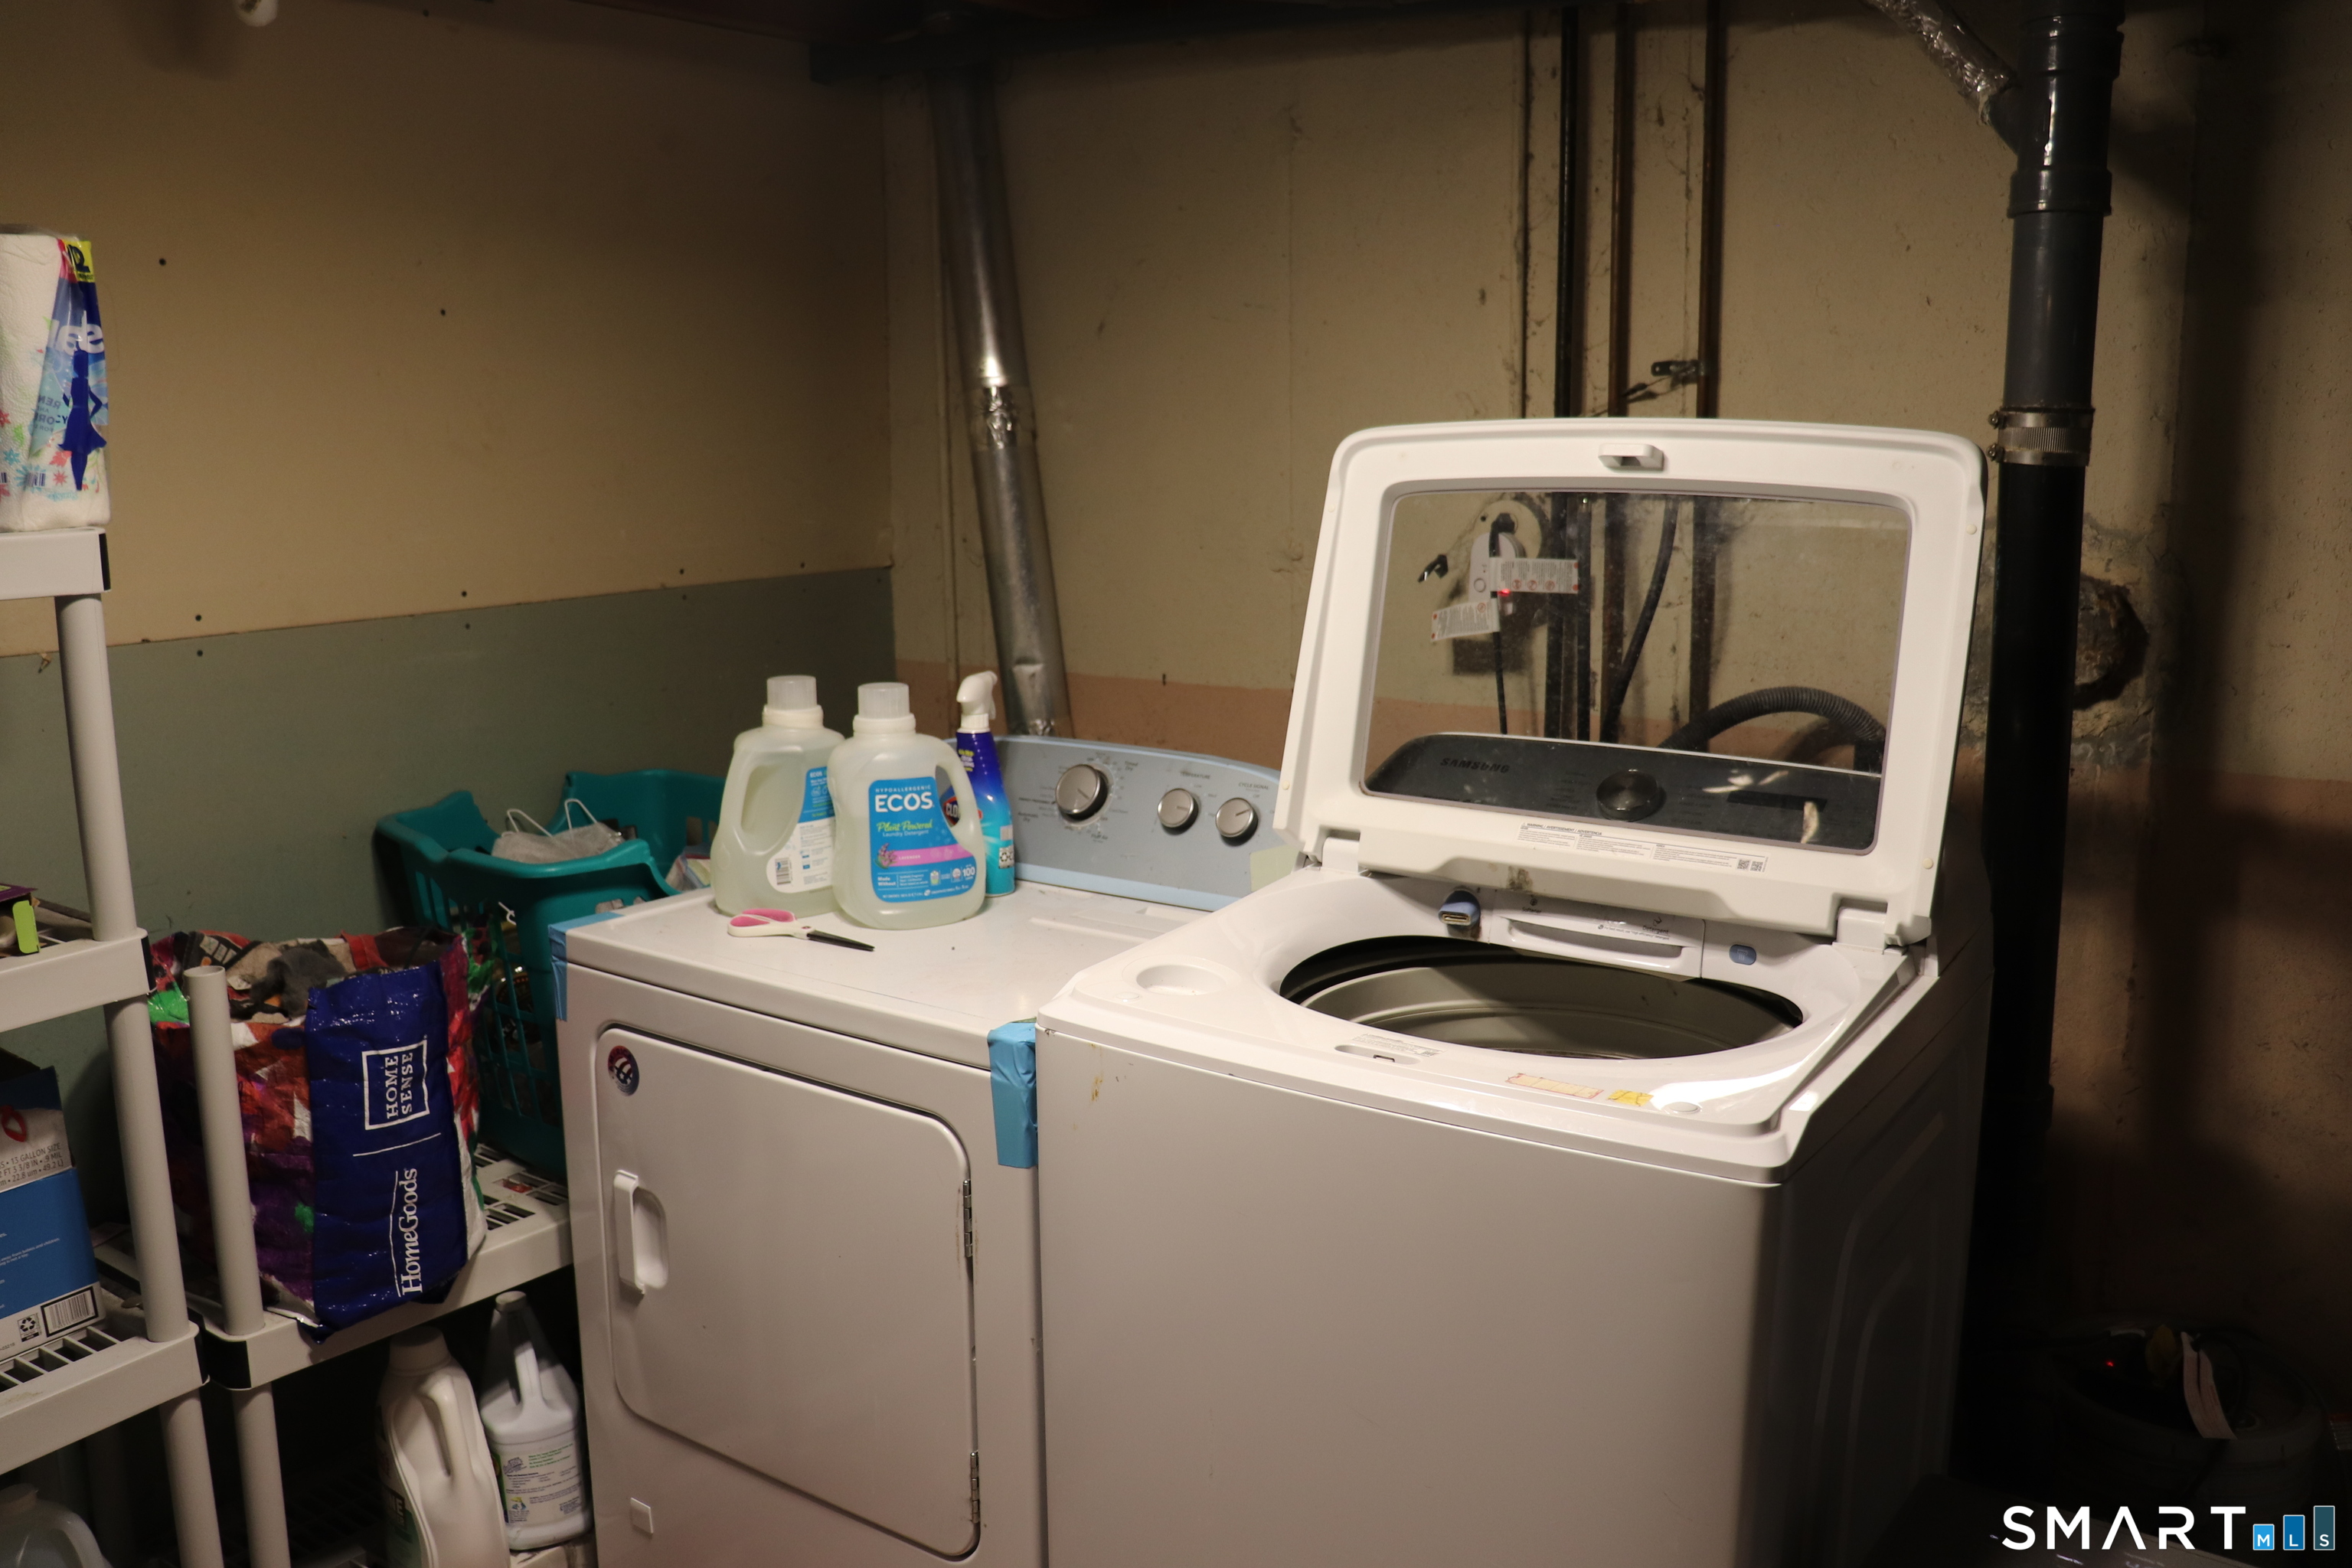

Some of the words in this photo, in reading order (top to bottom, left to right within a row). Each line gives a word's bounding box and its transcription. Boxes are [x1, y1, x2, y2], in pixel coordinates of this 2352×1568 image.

[1440, 757, 1510, 773] SAMSUNG
[1180, 771, 1210, 779] TEMPERATURE
[875, 791, 933, 812] ECOS
[876, 822, 901, 832] Plant
[901, 818, 933, 831] Powered
[962, 866, 975, 877] 100
[1521, 906, 1542, 914] Softener
[1642, 925, 1669, 935] Detergent
[385, 1055, 398, 1119] HOME
[400, 1052, 413, 1115] SENSE
[20, 1148, 46, 1161] GALLON
[47, 1142, 61, 1153] SIZE
[4, 1168, 11, 1176] FT
[18, 1162, 30, 1171] 3/8
[51, 1152, 62, 1160] MIL
[12, 1172, 26, 1182] 22.8
[43, 1161, 56, 1171] 49.2
[399, 1167, 423, 1296] HomeGoods
